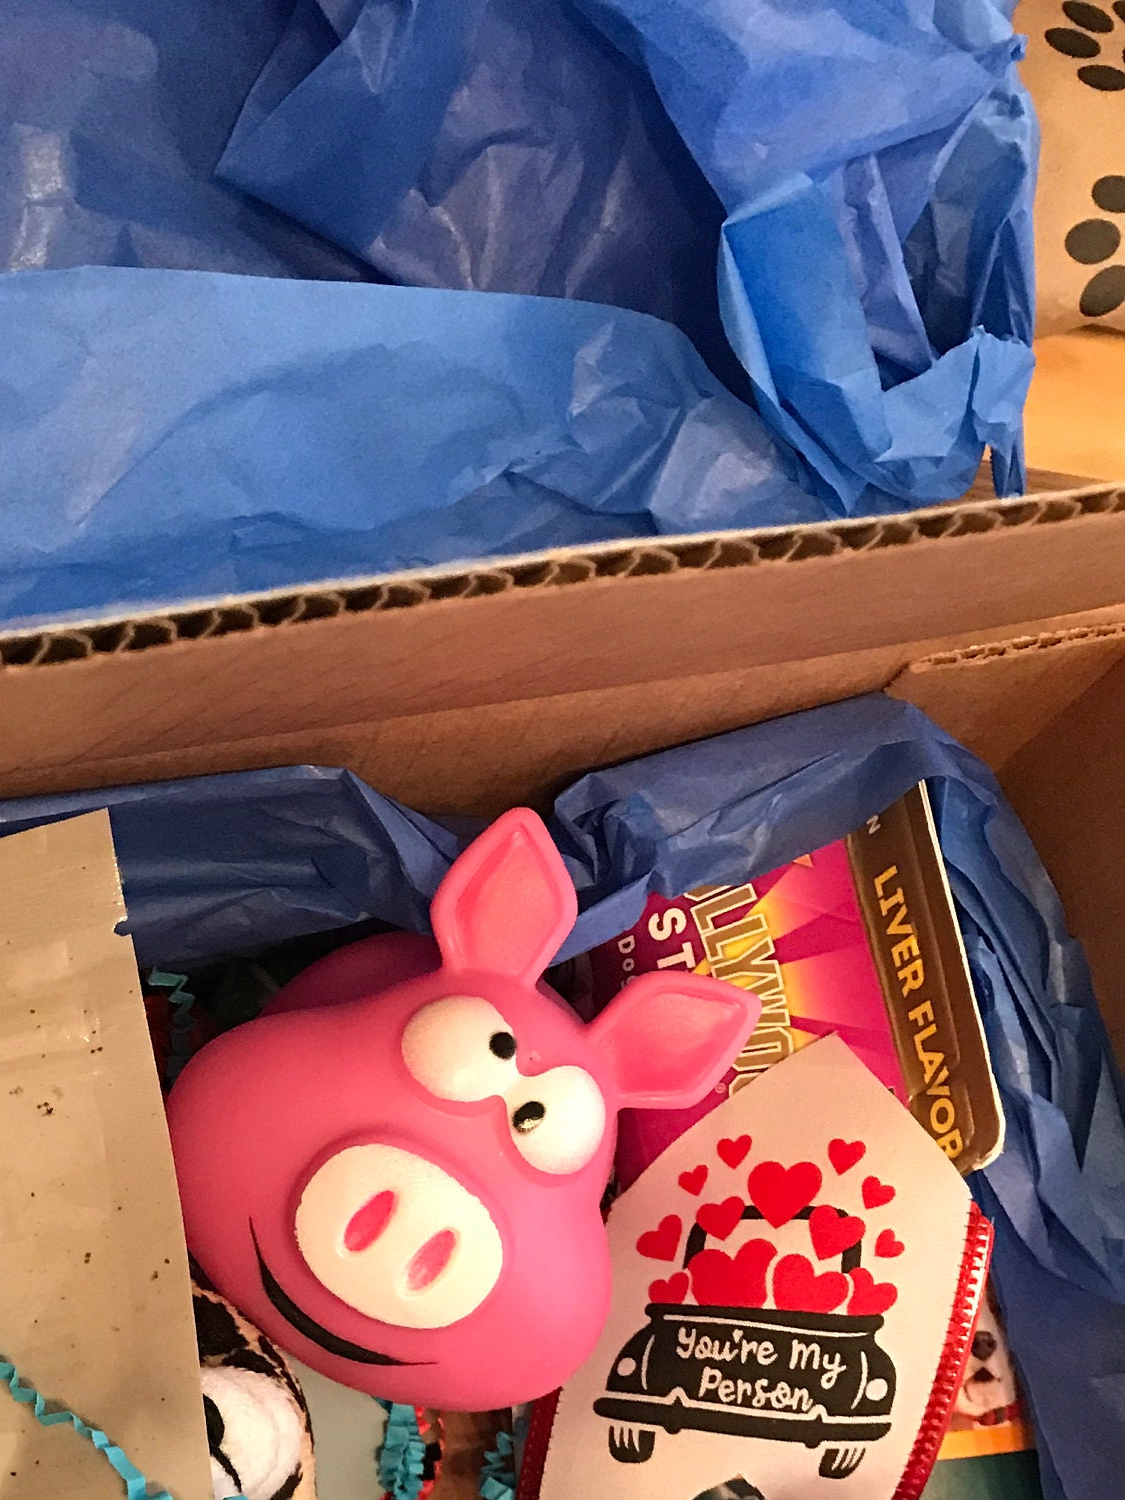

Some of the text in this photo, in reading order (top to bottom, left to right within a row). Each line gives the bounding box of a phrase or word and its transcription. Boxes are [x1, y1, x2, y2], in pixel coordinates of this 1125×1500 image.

[873, 864, 964, 1159] LIVER FLAVOR
[698, 1366, 814, 1412] Person
